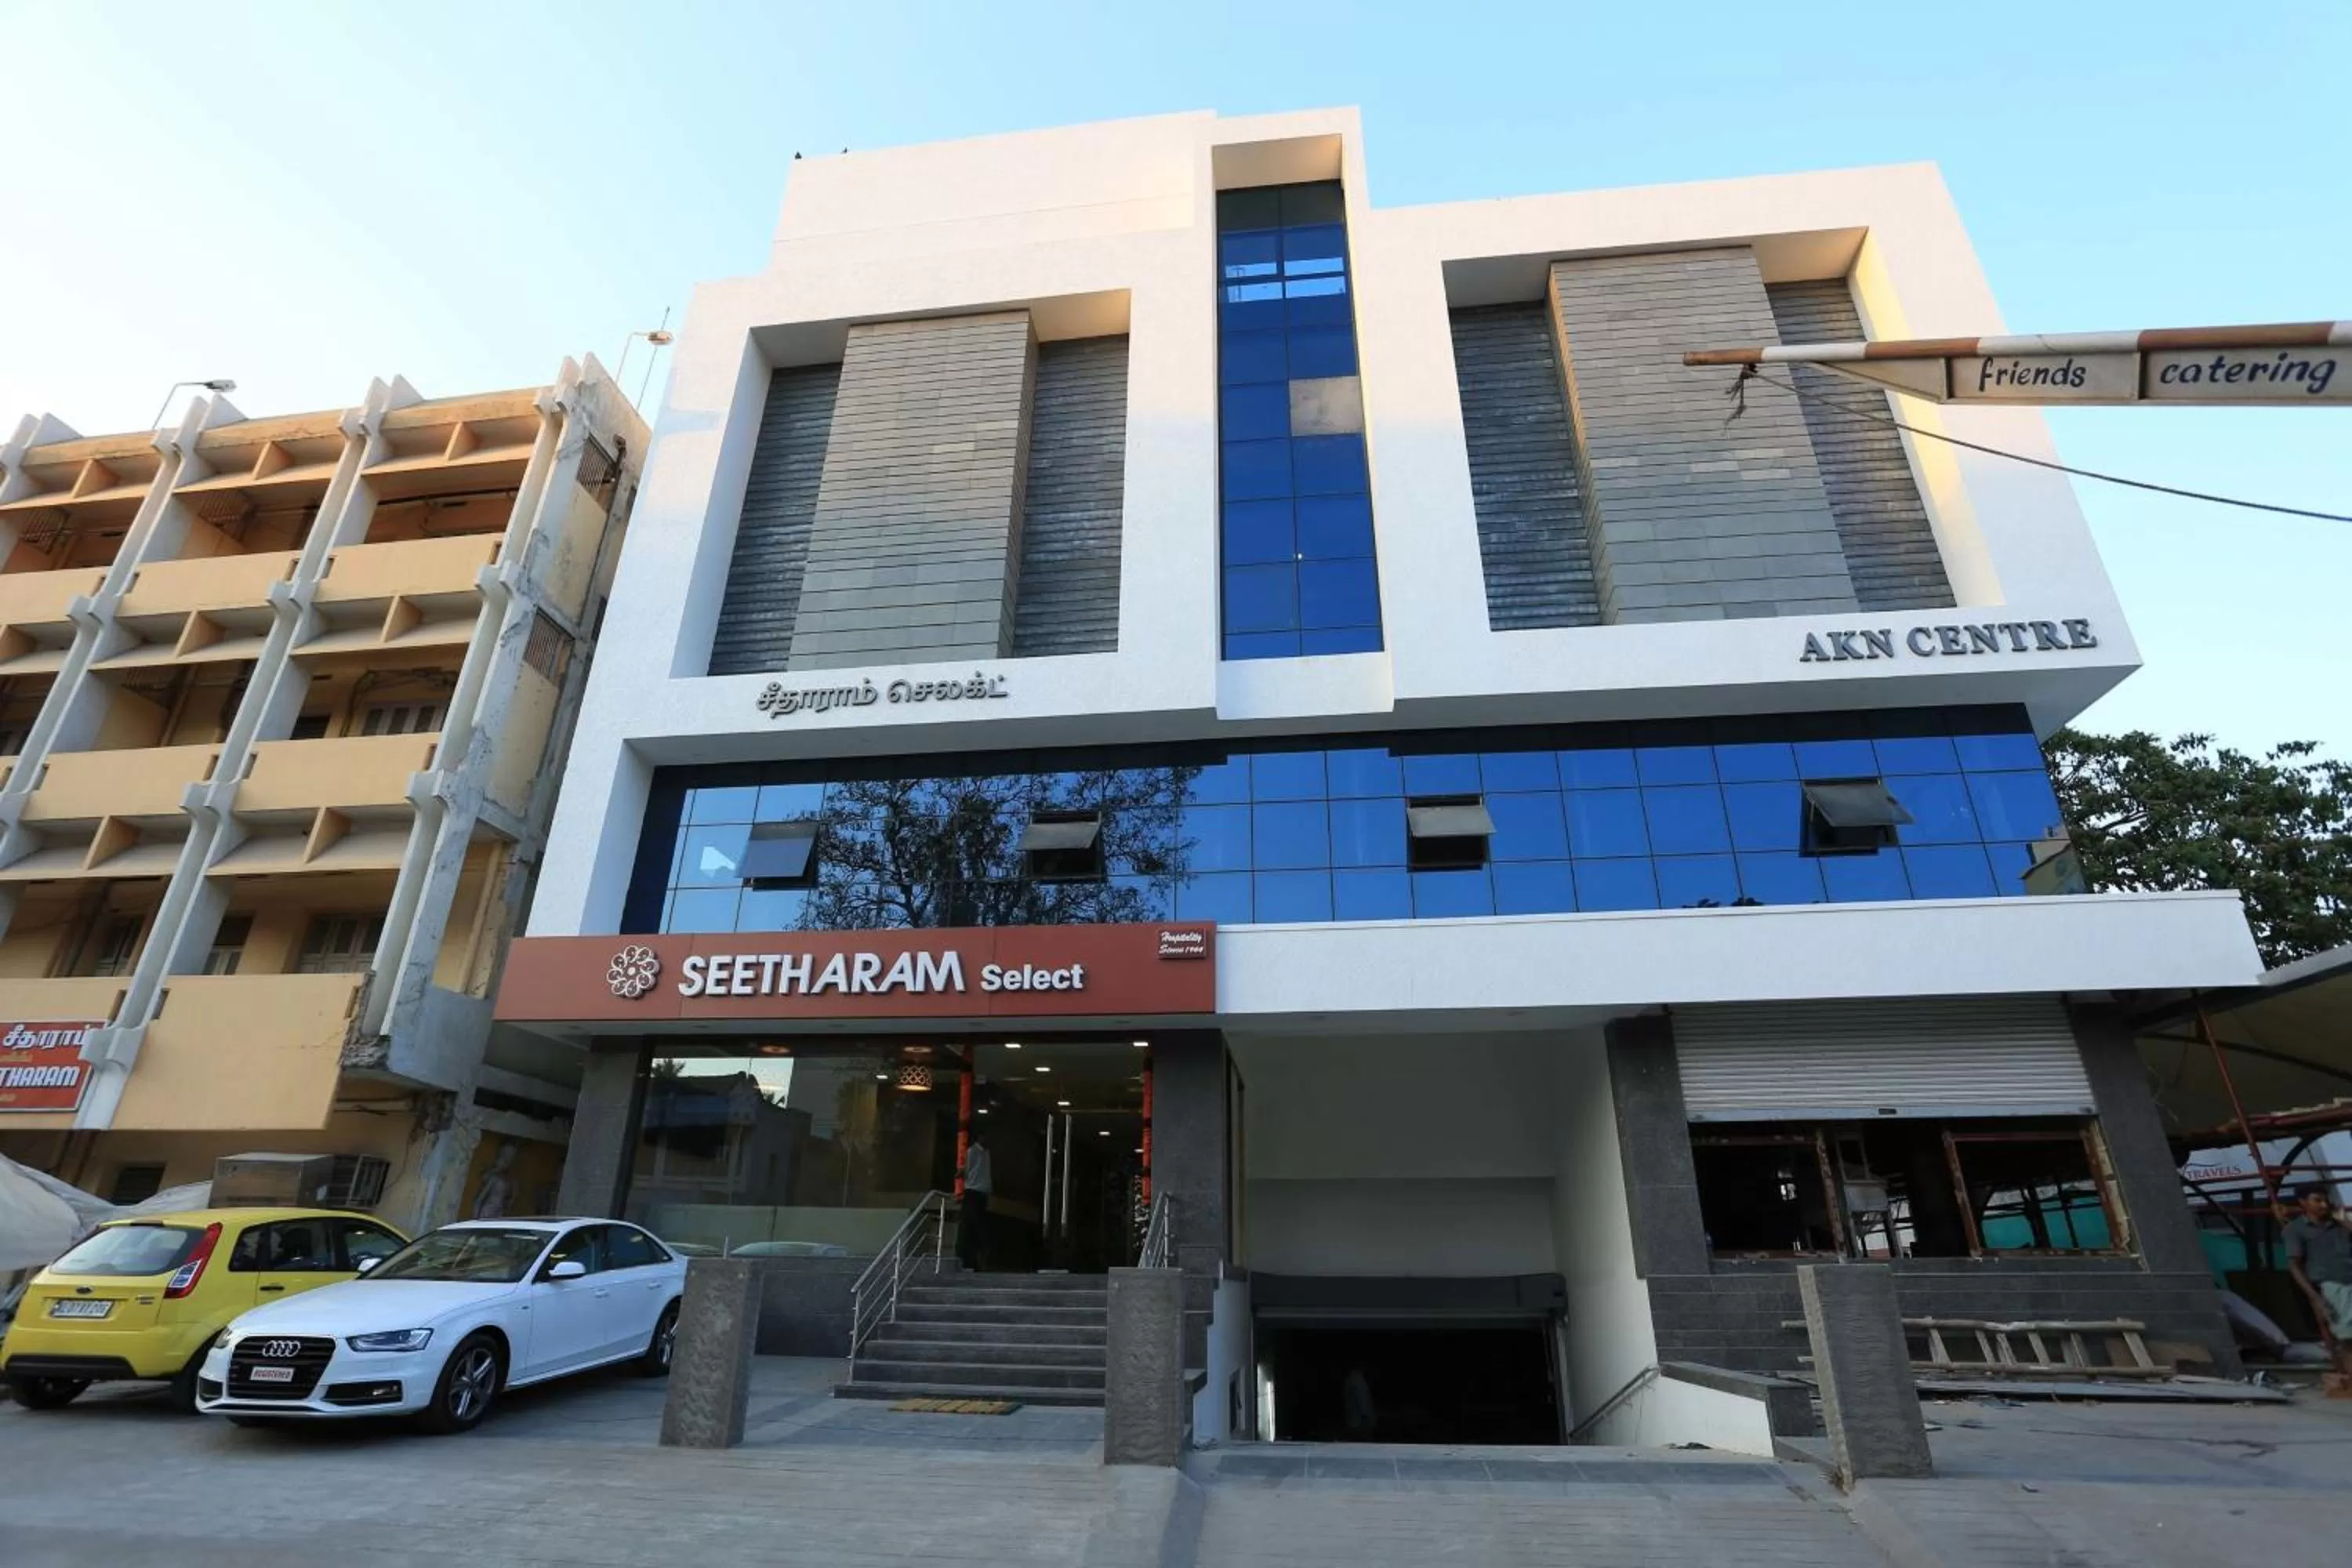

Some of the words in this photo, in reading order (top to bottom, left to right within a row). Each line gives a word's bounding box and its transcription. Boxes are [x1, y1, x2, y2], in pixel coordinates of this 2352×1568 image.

[1979, 357, 2086, 391] friends
[2160, 352, 2336, 394] catering
[1799, 629, 1895, 662] AKN
[1907, 619, 2099, 657] CENTRE
[755, 677, 879, 720] சீதாராம்
[887, 671, 1009, 703] செலக்ட்
[678, 951, 966, 996] SEETHARAM
[980, 964, 1083, 992] Select
[2186, 1166, 2241, 1180] TRAVELS
